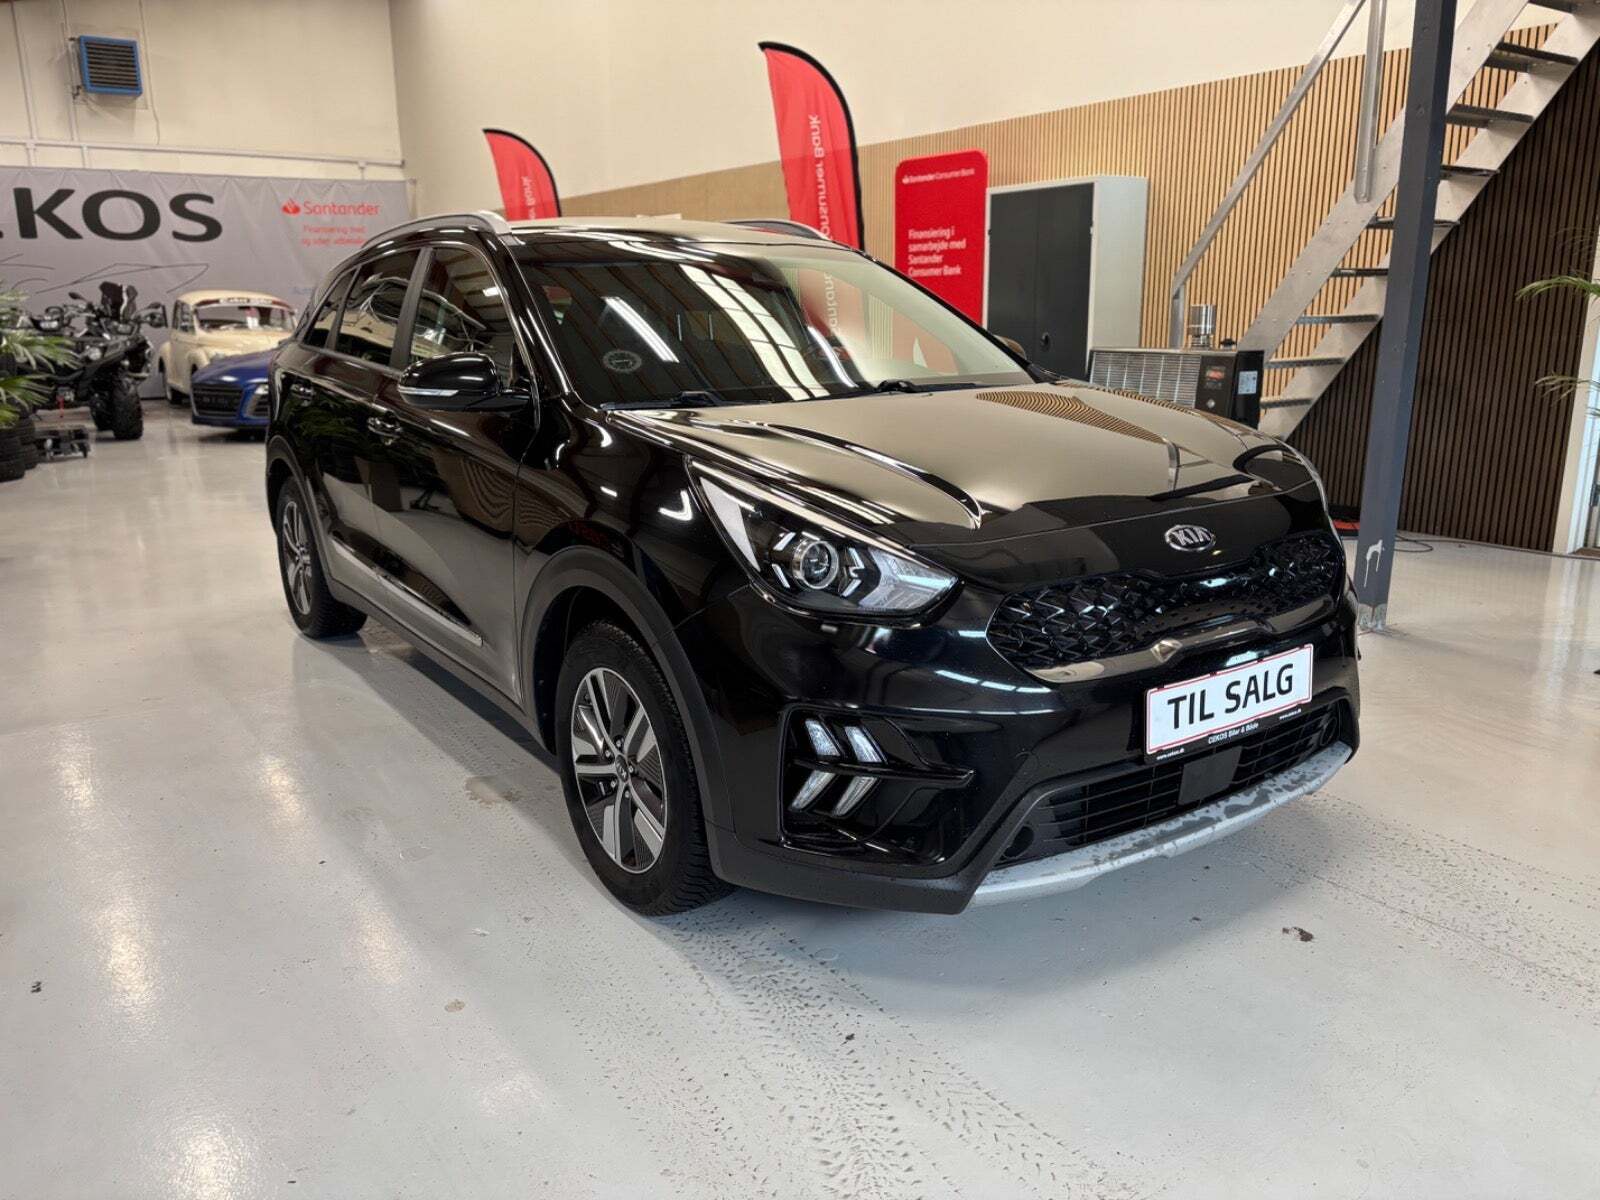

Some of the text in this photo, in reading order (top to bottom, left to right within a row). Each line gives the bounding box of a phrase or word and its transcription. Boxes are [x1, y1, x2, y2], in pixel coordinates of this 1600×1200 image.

[0, 187, 223, 242] KOS
[303, 200, 379, 215] Santander
[949, 238, 967, 249] med
[908, 254, 944, 265] Santander
[908, 264, 962, 277] Consumer Bank
[1169, 527, 1211, 546] KIA
[1167, 663, 1294, 730] TIL SALG
